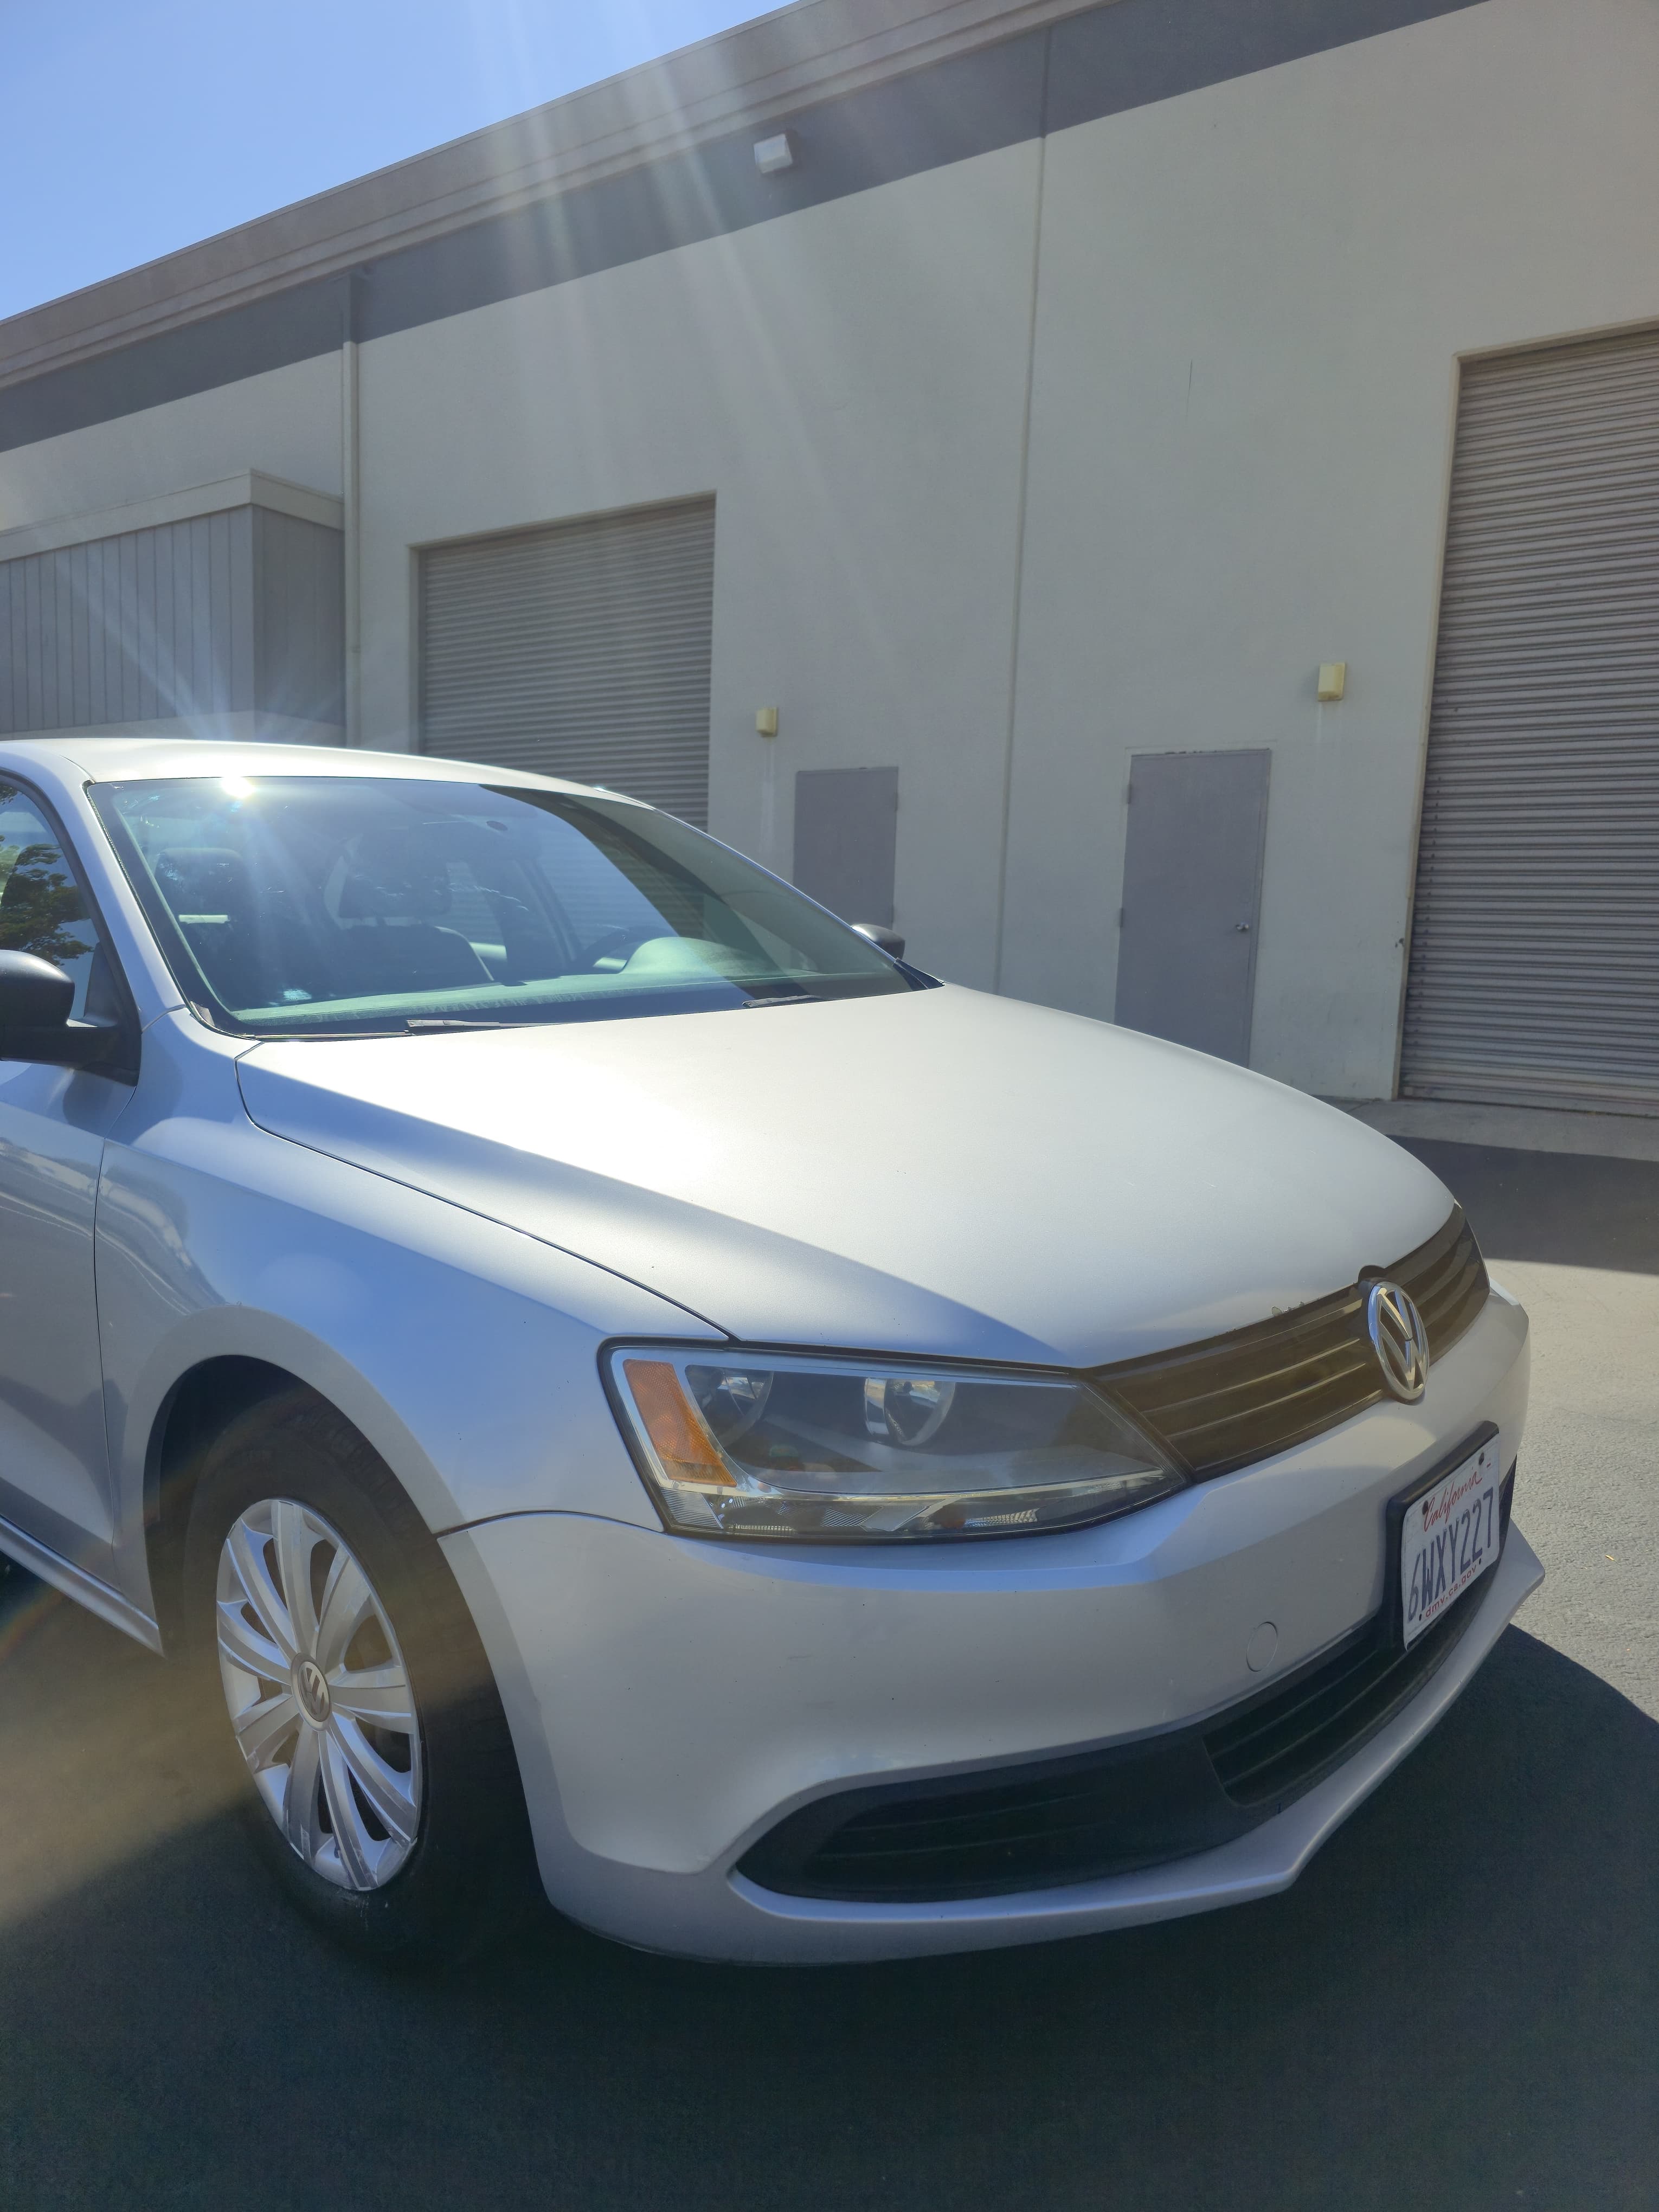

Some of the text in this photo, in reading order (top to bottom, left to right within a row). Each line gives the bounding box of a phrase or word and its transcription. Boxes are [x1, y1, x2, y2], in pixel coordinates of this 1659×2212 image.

[1424, 1468, 1482, 1532] California
[1408, 1486, 1493, 1622] 6WXY227
[1425, 1565, 1477, 1617] dmv.ca.gov
